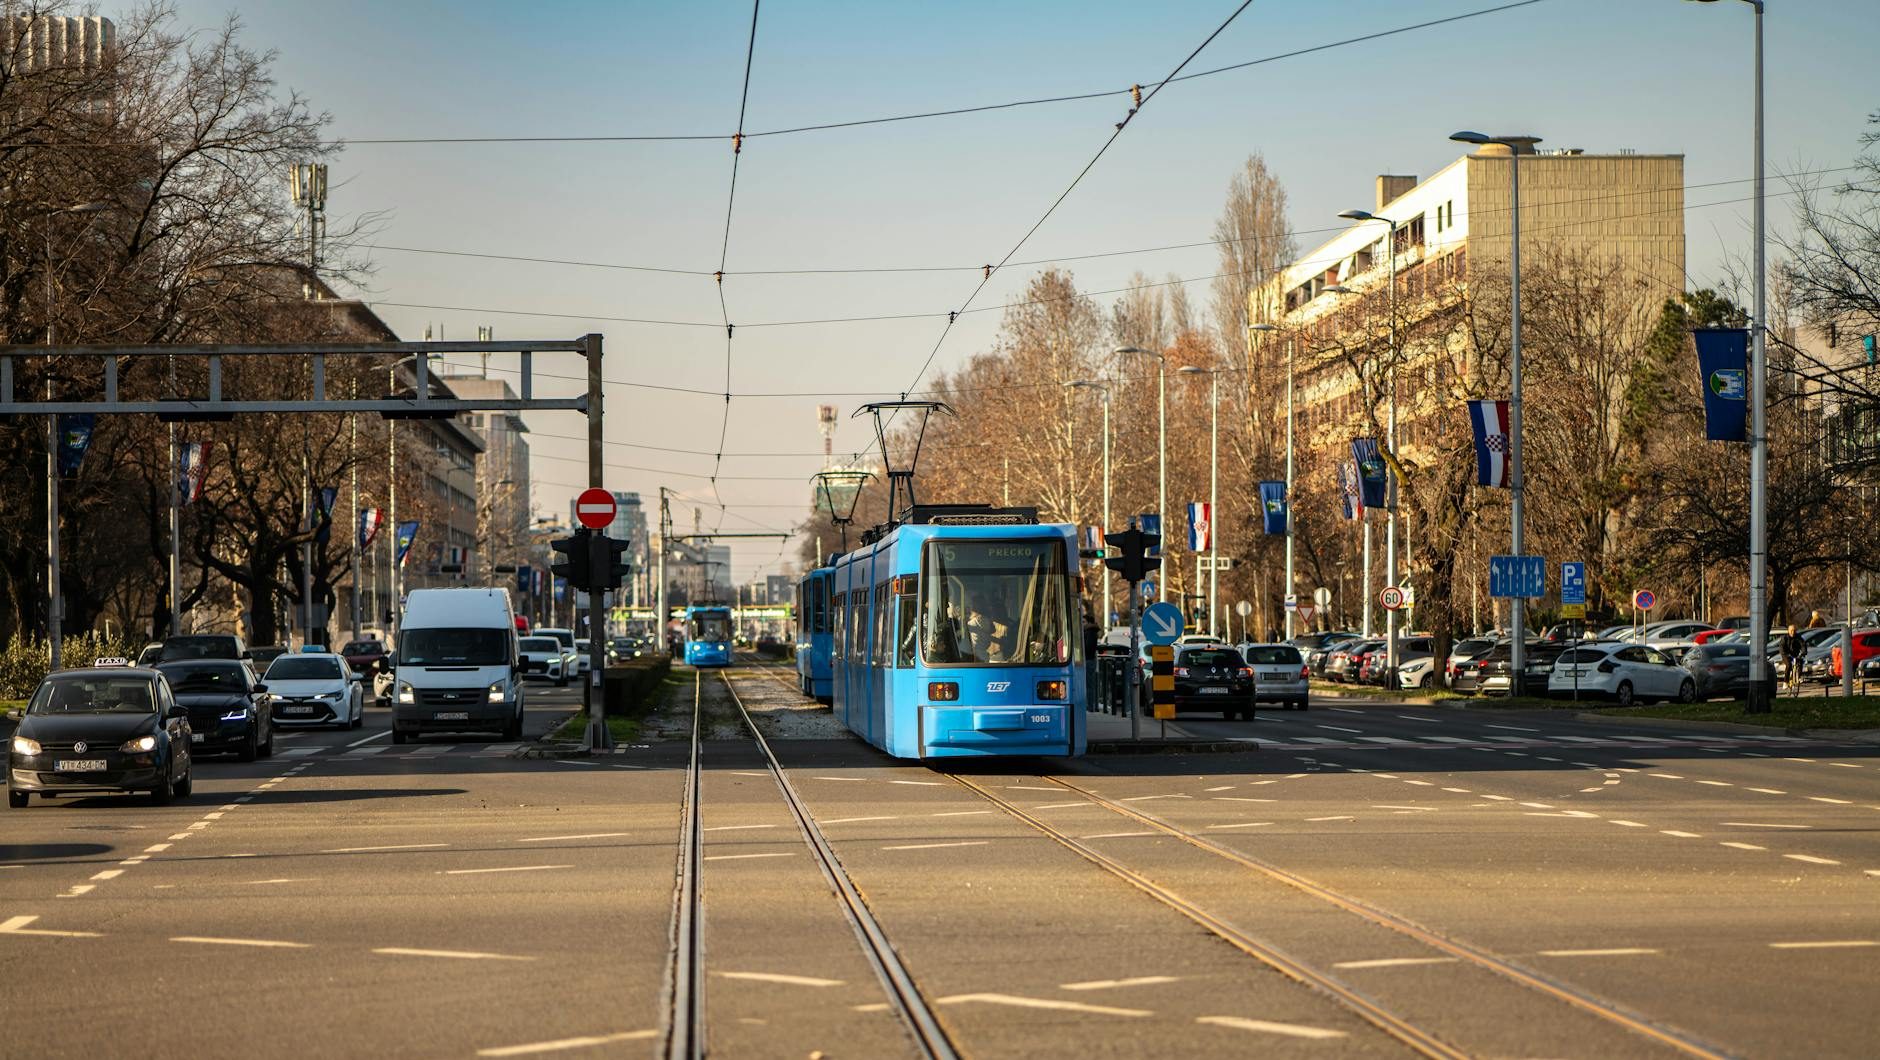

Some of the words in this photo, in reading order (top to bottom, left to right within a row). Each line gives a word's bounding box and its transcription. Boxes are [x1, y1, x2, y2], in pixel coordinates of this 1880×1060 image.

[945, 546, 956, 561] 5
[1564, 565, 1576, 585] P
[1385, 593, 1398, 604] 60
[986, 682, 1010, 692] ZET
[1031, 715, 1050, 723] 1003
